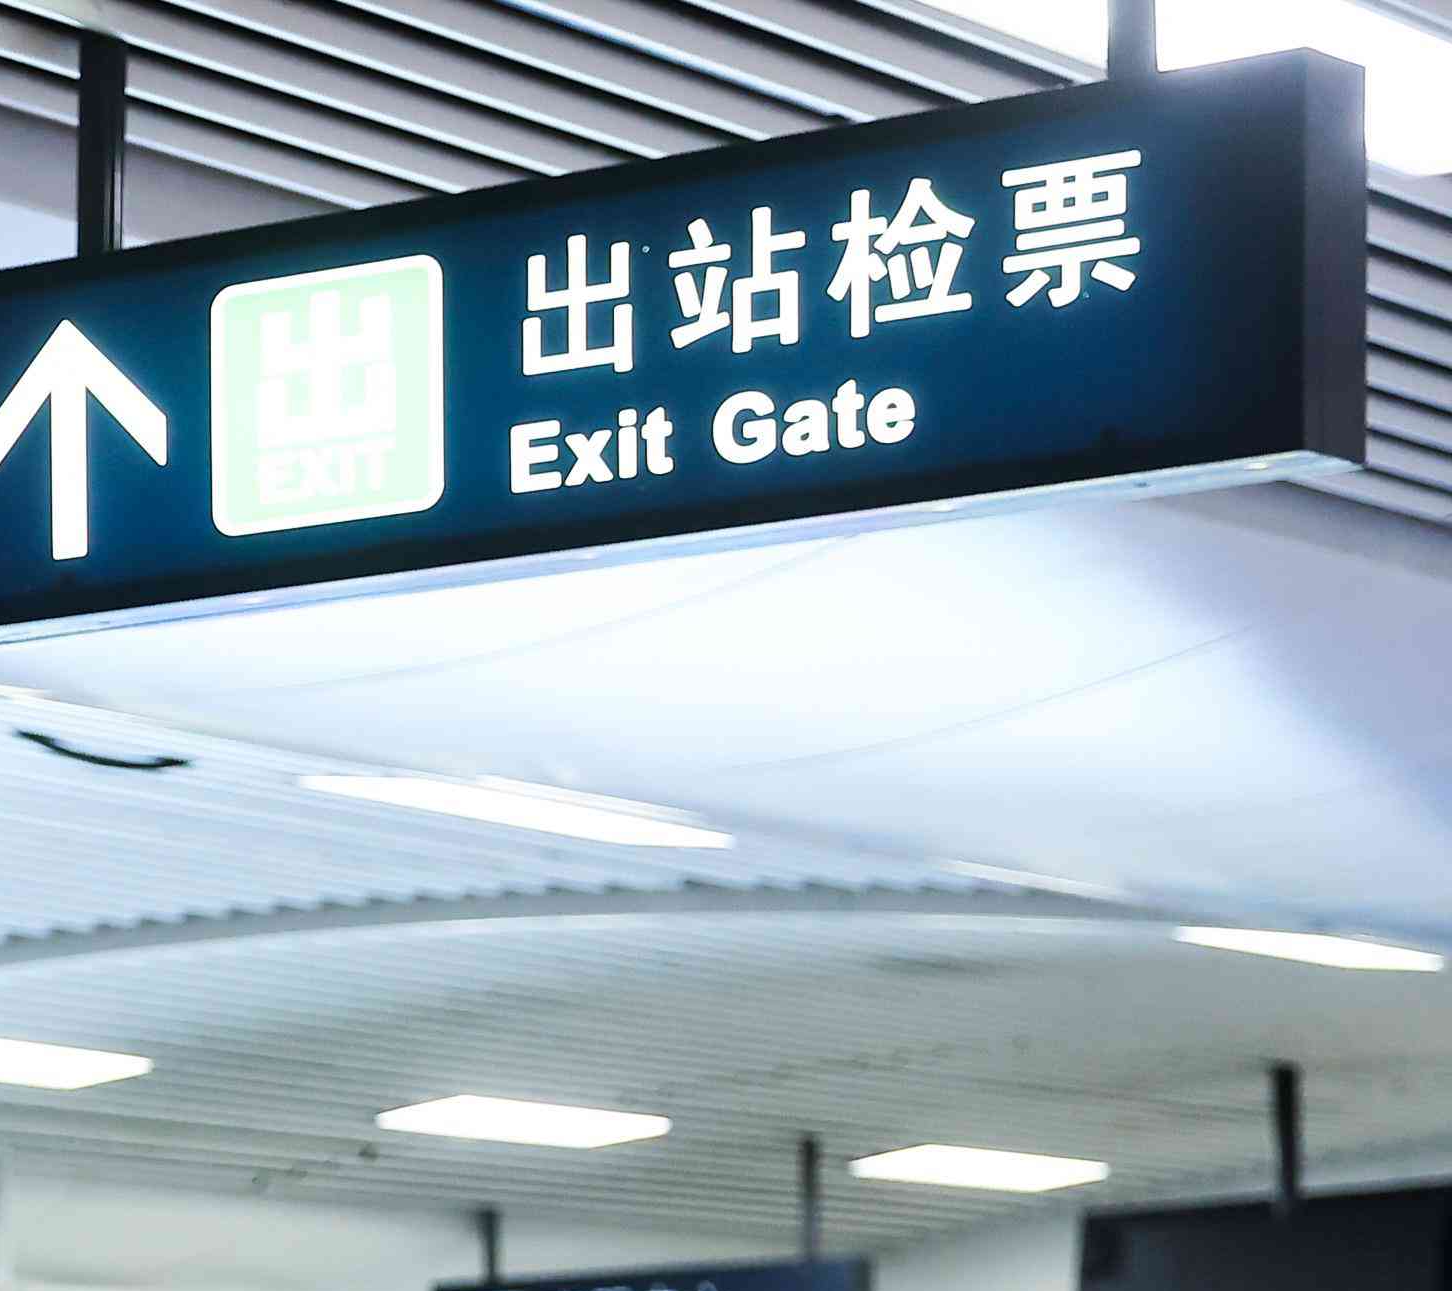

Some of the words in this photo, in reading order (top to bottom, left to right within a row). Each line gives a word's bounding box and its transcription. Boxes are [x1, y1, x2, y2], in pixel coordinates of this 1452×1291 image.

[519, 148, 1142, 379] 出站检票
[510, 416, 676, 494] Exit
[713, 378, 916, 466] Gate
